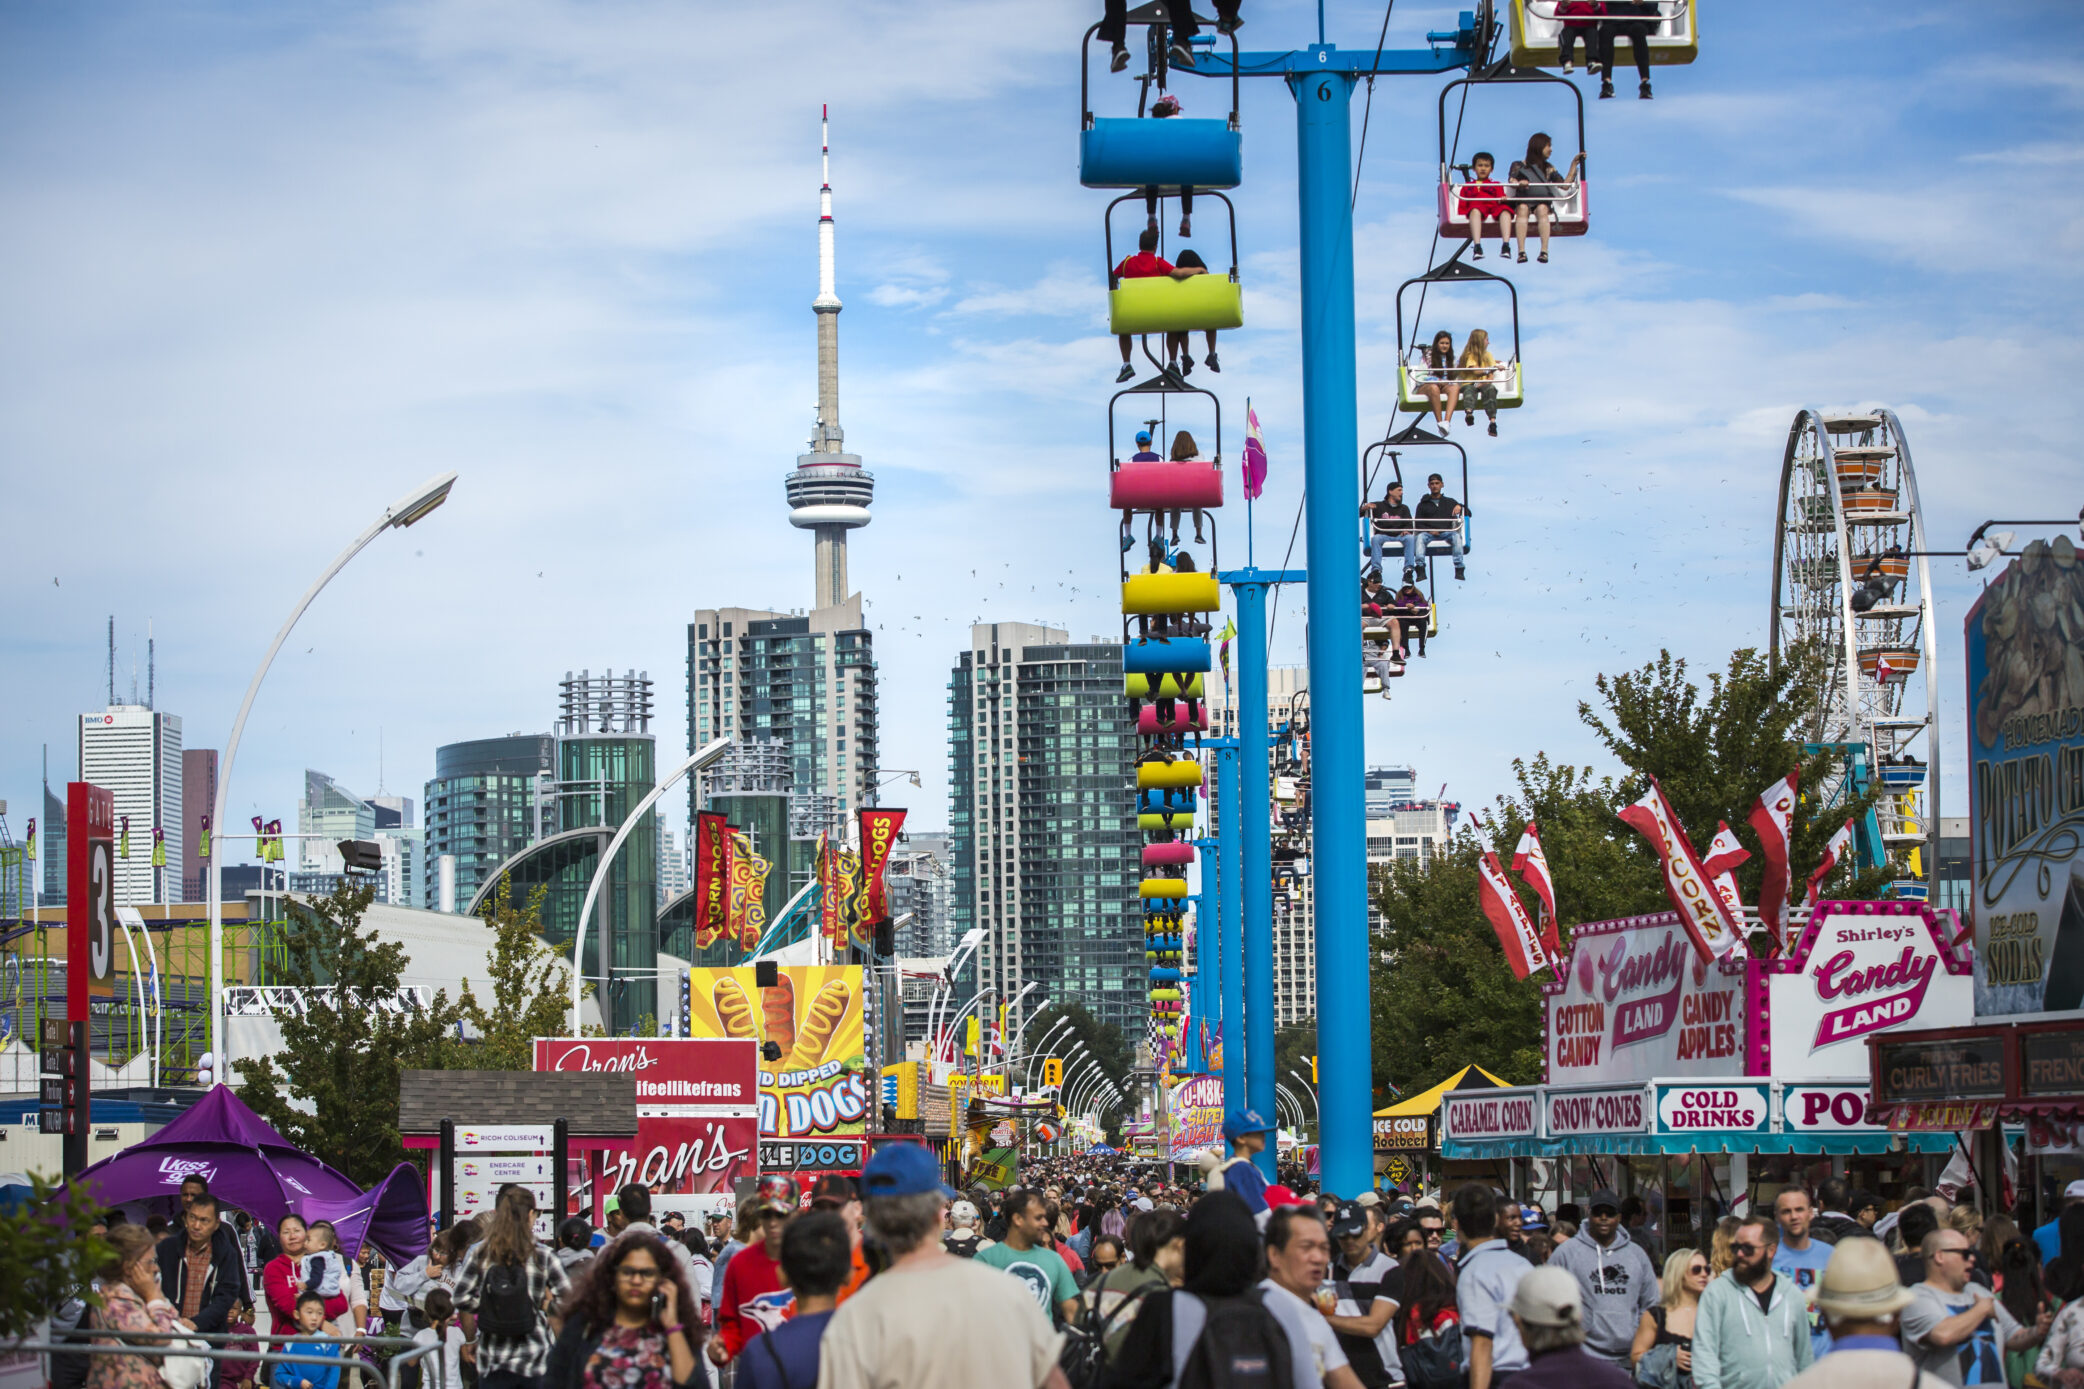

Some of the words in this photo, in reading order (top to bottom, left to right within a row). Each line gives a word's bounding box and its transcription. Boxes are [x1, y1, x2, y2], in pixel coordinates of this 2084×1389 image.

[1319, 51, 1327, 63] 6
[1318, 80, 1331, 102] 6
[1248, 588, 1255, 600] 7
[1226, 752, 1231, 760] 8
[89, 797, 112, 830] GATE
[1977, 753, 2053, 885] POTATO
[92, 845, 109, 980] 3
[1989, 912, 2038, 939] ICE-COLD
[1837, 926, 1915, 943] Shirley's
[1598, 931, 1689, 1003] Candy
[1813, 946, 1938, 1000] Candy
[1987, 937, 2042, 986] SODAS
[1556, 1002, 1605, 1036] COTTON
[1623, 1002, 1664, 1036] LAND
[1682, 989, 1735, 1026] CANDY
[1831, 998, 1912, 1036] LAND
[1557, 1036, 1602, 1068] CANDY
[1676, 1023, 1736, 1061] APPLES
[778, 1060, 842, 1088] DIPPED
[1890, 1064, 1945, 1090] CURLY
[1951, 1061, 2001, 1086] FRIES
[1681, 1091, 1738, 1109] COLD
[1373, 1119, 1391, 1134] ICE
[1394, 1118, 1426, 1132] COLD
[1450, 1101, 1500, 1134] CARAMEL
[1502, 1100, 1532, 1132] CORN
[1671, 1109, 1755, 1128] DRINKS
[1916, 1106, 1974, 1127] POUTINE
[800, 1145, 856, 1165] DOG
[1373, 1134, 1426, 1148] Rootbeer
[1594, 1284, 1626, 1295] Roots
